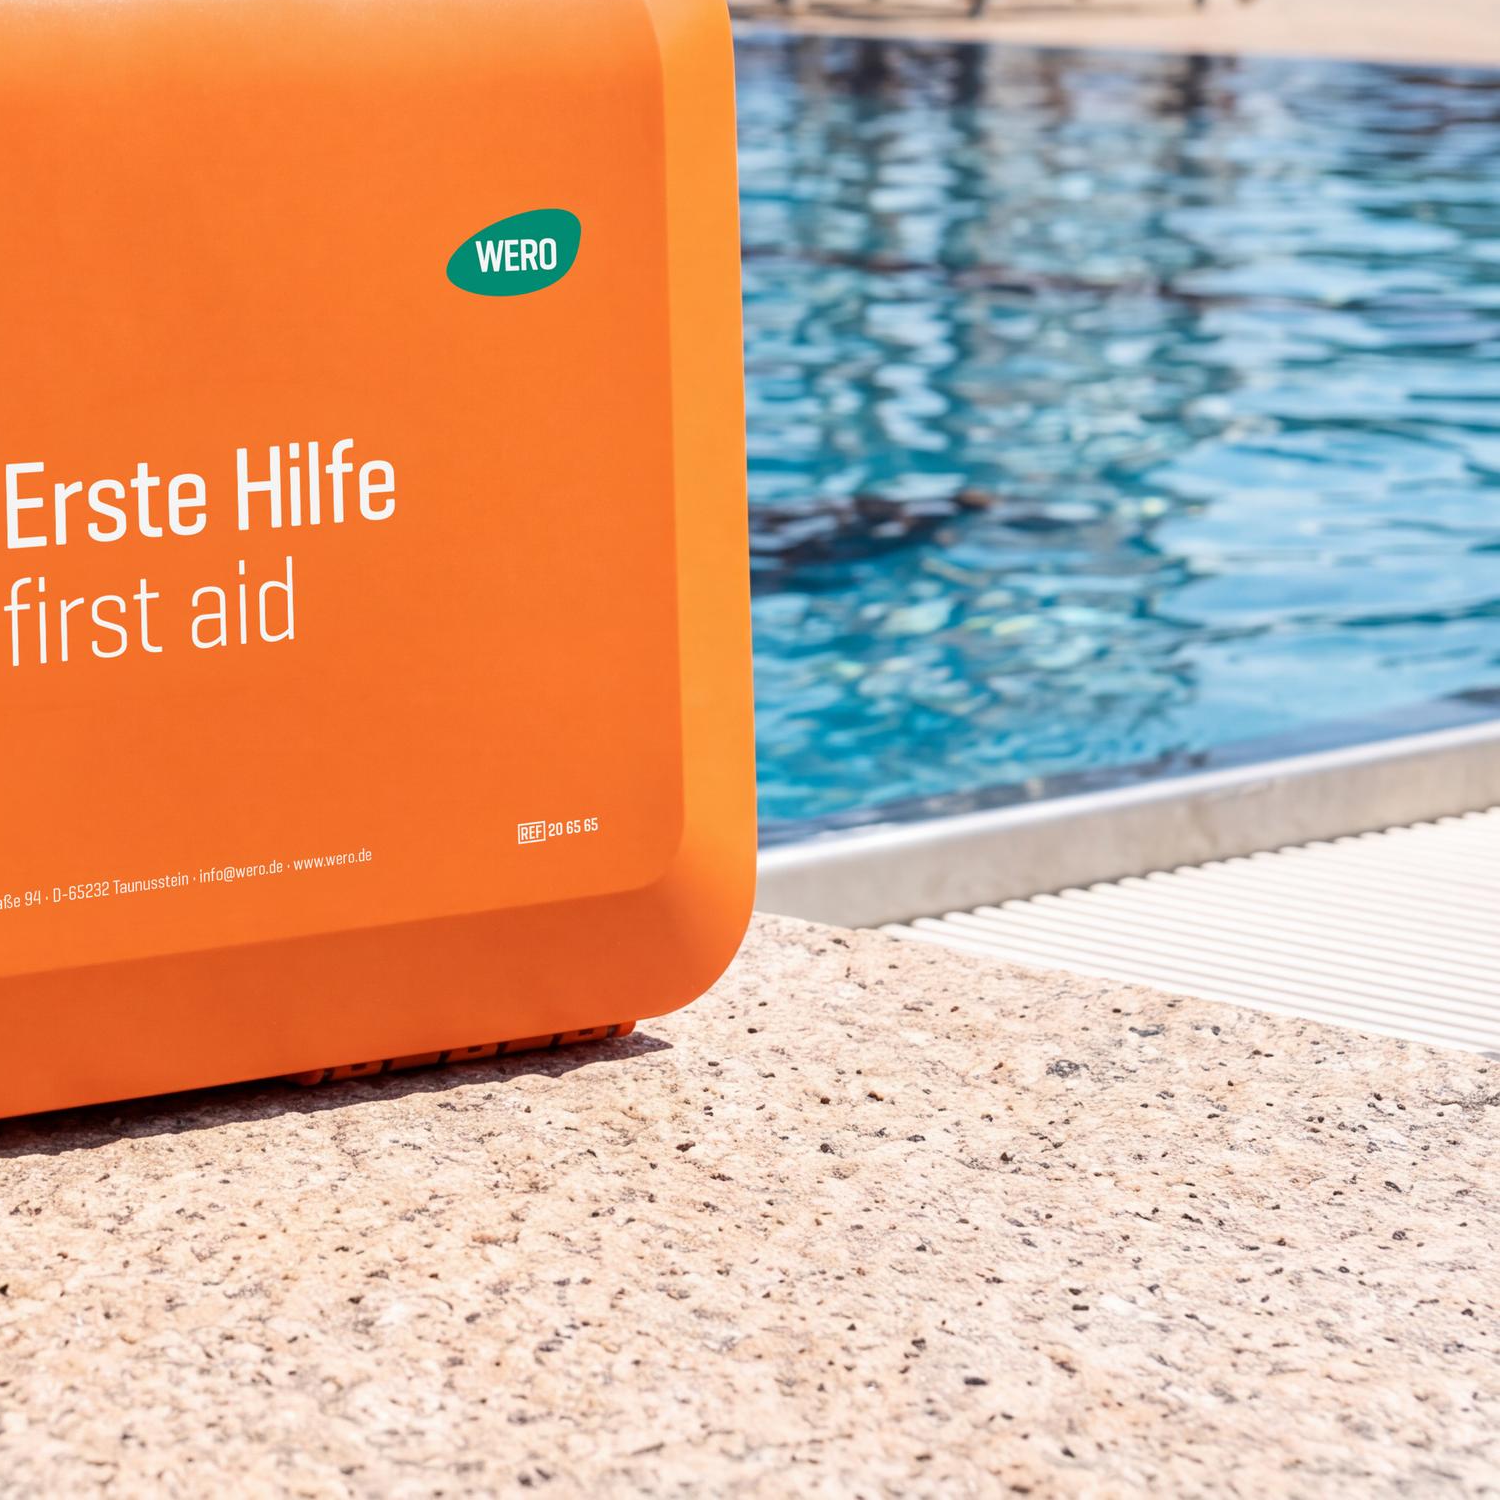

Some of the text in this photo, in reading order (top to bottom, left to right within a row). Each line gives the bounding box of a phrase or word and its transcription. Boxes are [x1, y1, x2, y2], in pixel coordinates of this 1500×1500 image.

[475, 237, 557, 273] WERO
[5, 438, 396, 550] Erste Hilfe
[3, 555, 295, 667] first aid
[520, 816, 599, 841] REF 20 65 65
[24, 889, 42, 906] 94
[53, 880, 110, 903] D-65232
[112, 871, 189, 895] Taunusstein
[199, 859, 284, 884] info@wero.de
[293, 847, 373, 871] www.wero.de
